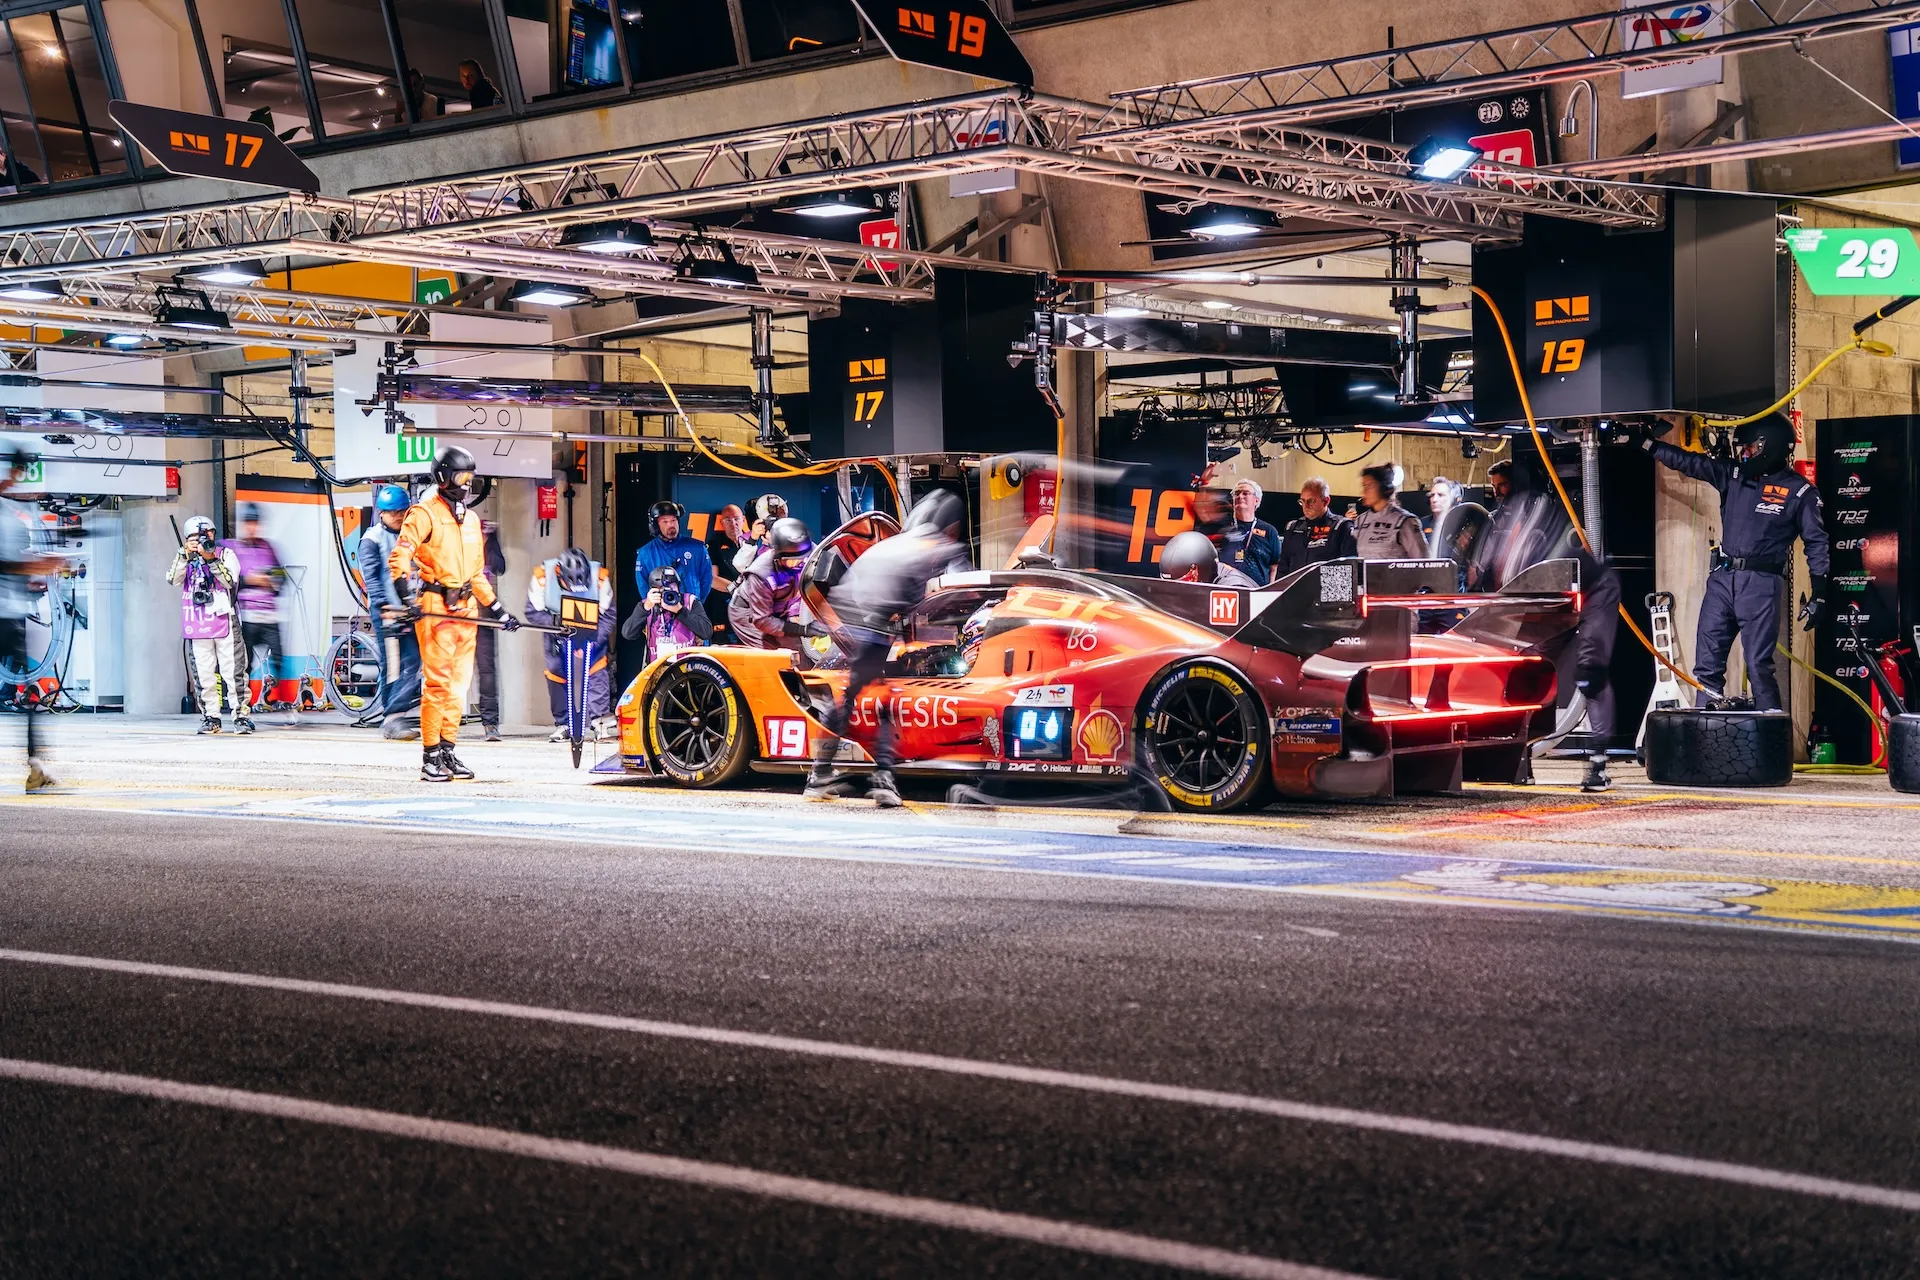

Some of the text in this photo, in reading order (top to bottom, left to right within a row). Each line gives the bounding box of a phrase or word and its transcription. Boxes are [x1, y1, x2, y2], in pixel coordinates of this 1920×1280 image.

[948, 11, 986, 57] 19
[1481, 105, 1500, 119] FIA
[225, 133, 263, 168] 17
[1836, 239, 1899, 279] 29
[1541, 339, 1585, 374] 19
[854, 390, 884, 422] 17
[402, 436, 431, 461] 10
[1127, 489, 1196, 563] 19
[1837, 510, 1869, 520] TDS
[1836, 539, 1857, 550] elf
[1213, 597, 1236, 619] HY
[694, 663, 726, 686] MICHELIN
[1836, 667, 1857, 677] elf
[1151, 670, 1185, 710] MICHELIN
[768, 719, 806, 757] 19
[1008, 763, 1036, 772] DAC
[1050, 764, 1071, 773] Helinox
[1215, 763, 1251, 802] MICHELIN
